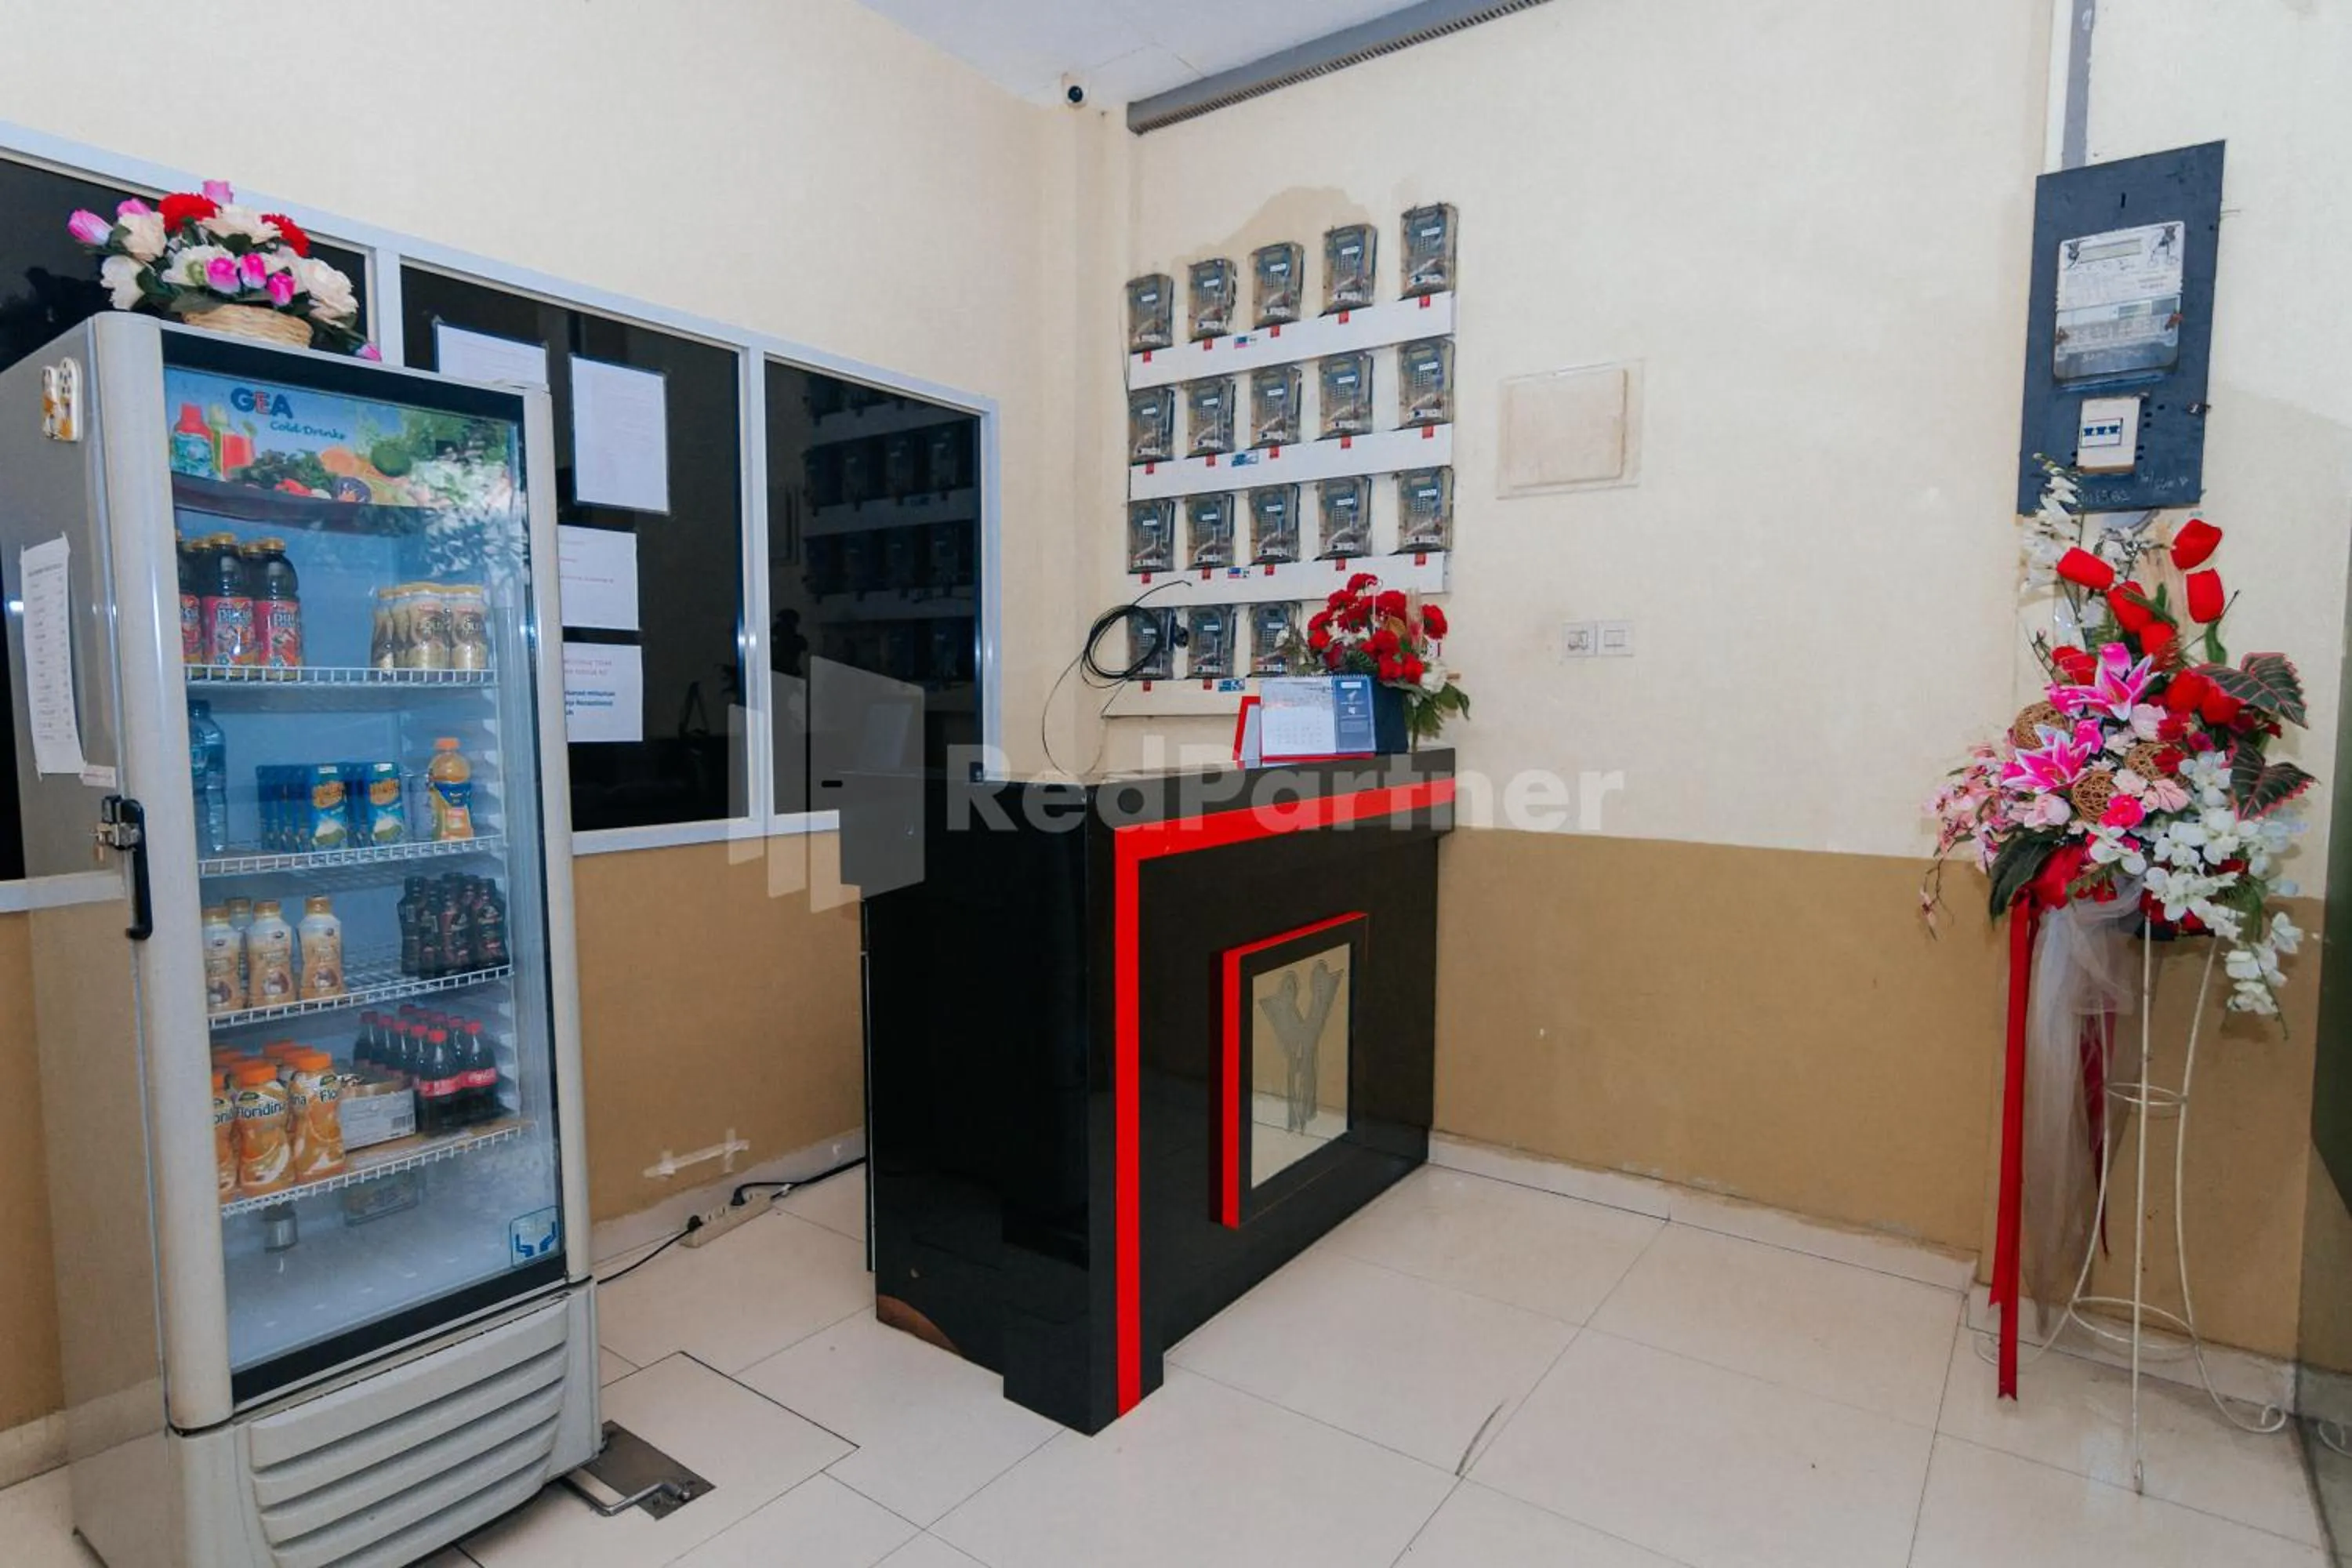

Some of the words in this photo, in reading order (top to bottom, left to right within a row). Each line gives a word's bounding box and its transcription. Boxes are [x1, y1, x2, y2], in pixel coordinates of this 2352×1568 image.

[230, 387, 293, 419] GEA
[270, 420, 299, 434] Cold
[303, 424, 346, 441] Drinks
